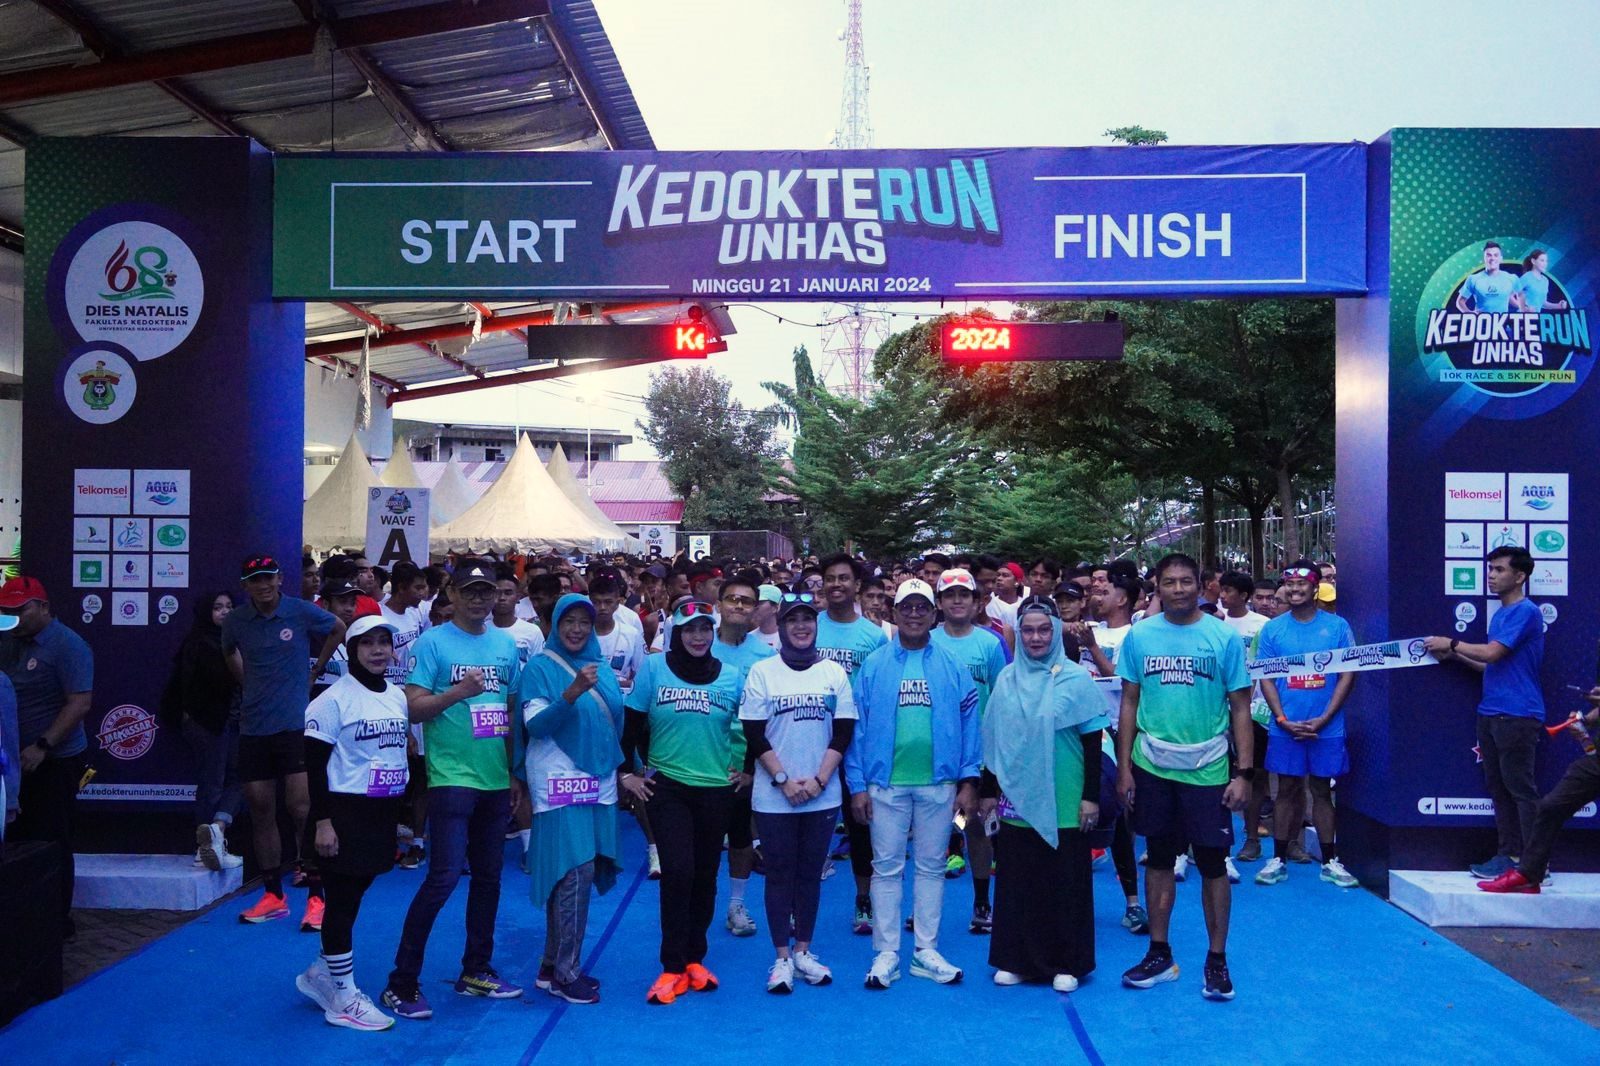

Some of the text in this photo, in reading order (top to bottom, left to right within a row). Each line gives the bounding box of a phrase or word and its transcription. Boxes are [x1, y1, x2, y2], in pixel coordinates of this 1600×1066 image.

[606, 158, 1000, 233] KEDOKTERUN
[400, 219, 577, 264] START
[1054, 212, 1232, 259] FINISH
[717, 221, 887, 266] UNHAS
[692, 277, 931, 293] MINGGU 21 JANUARI 2024
[85, 305, 189, 317] DIES NATALIS
[1425, 309, 1591, 349] KEDOKTERUN
[950, 327, 1011, 350] 2024
[1471, 341, 1544, 366] UNHAS
[1444, 372, 1463, 380] 10K
[1466, 372, 1493, 380] RACE
[1507, 372, 1521, 380] 5K
[1524, 372, 1546, 380] FUN
[77, 485, 128, 495] Telkomsel
[145, 481, 178, 495] AQUA
[1449, 489, 1502, 499] Telkomsel
[1520, 485, 1556, 499] AQUA
[380, 515, 416, 526] WAVE
[377, 528, 414, 566] A
[1143, 655, 1217, 680] KEDOKTERUN
[1161, 671, 1195, 685] UNHAS
[675, 699, 711, 714] UNHAS
[900, 693, 932, 706] UNHAS
[479, 711, 504, 726] 5580
[794, 707, 826, 721] UNHAS
[378, 732, 406, 749] UNHAS
[378, 770, 404, 785] 5859
[556, 778, 589, 794] 5820
